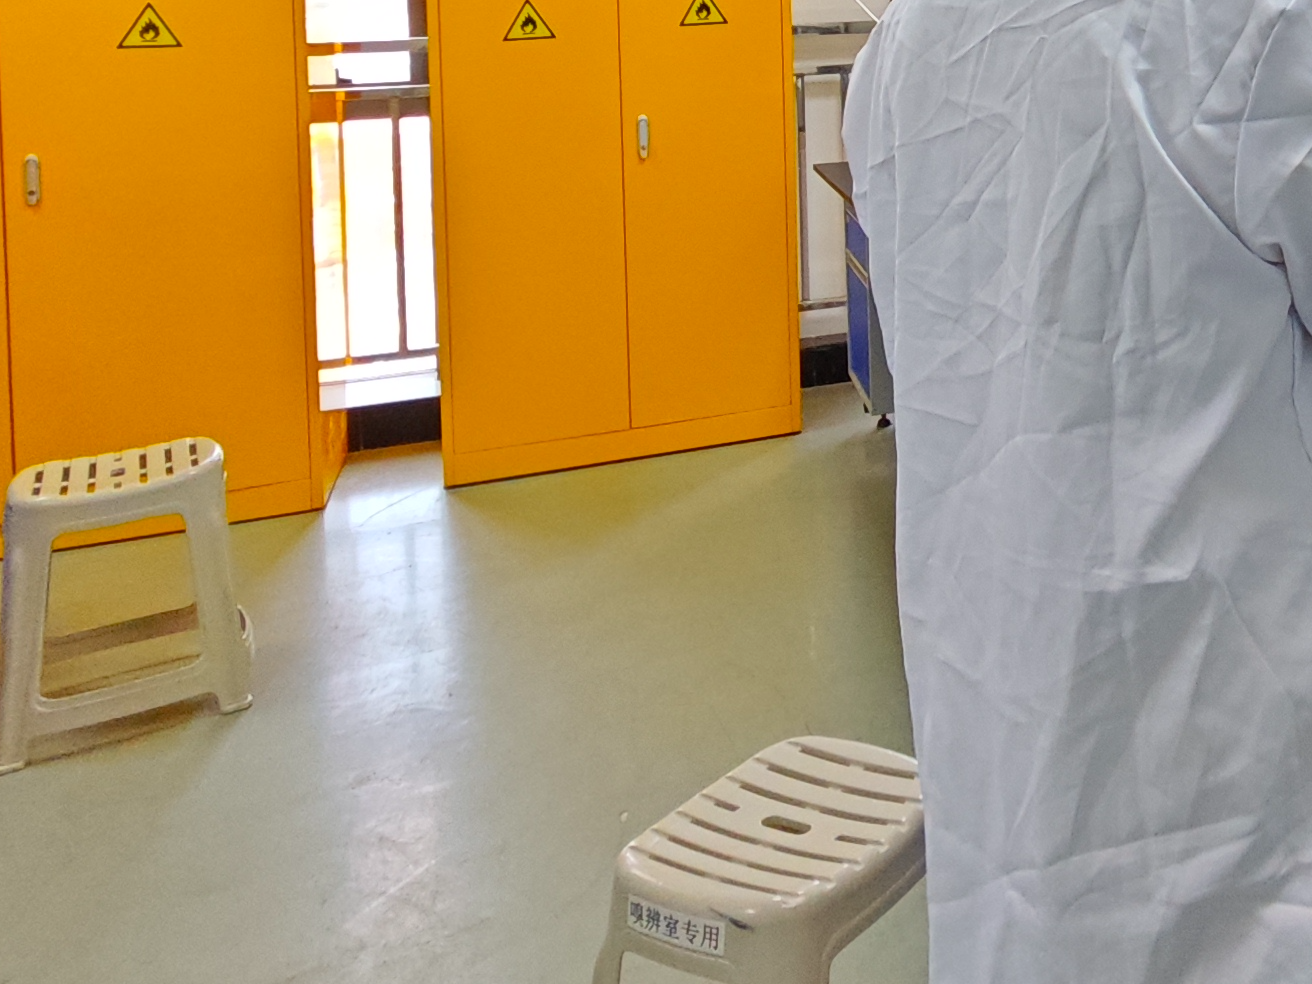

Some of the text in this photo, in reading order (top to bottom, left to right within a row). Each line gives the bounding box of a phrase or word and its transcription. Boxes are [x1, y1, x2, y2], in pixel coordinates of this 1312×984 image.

[630, 902, 720, 951] 嗅辨室专用
